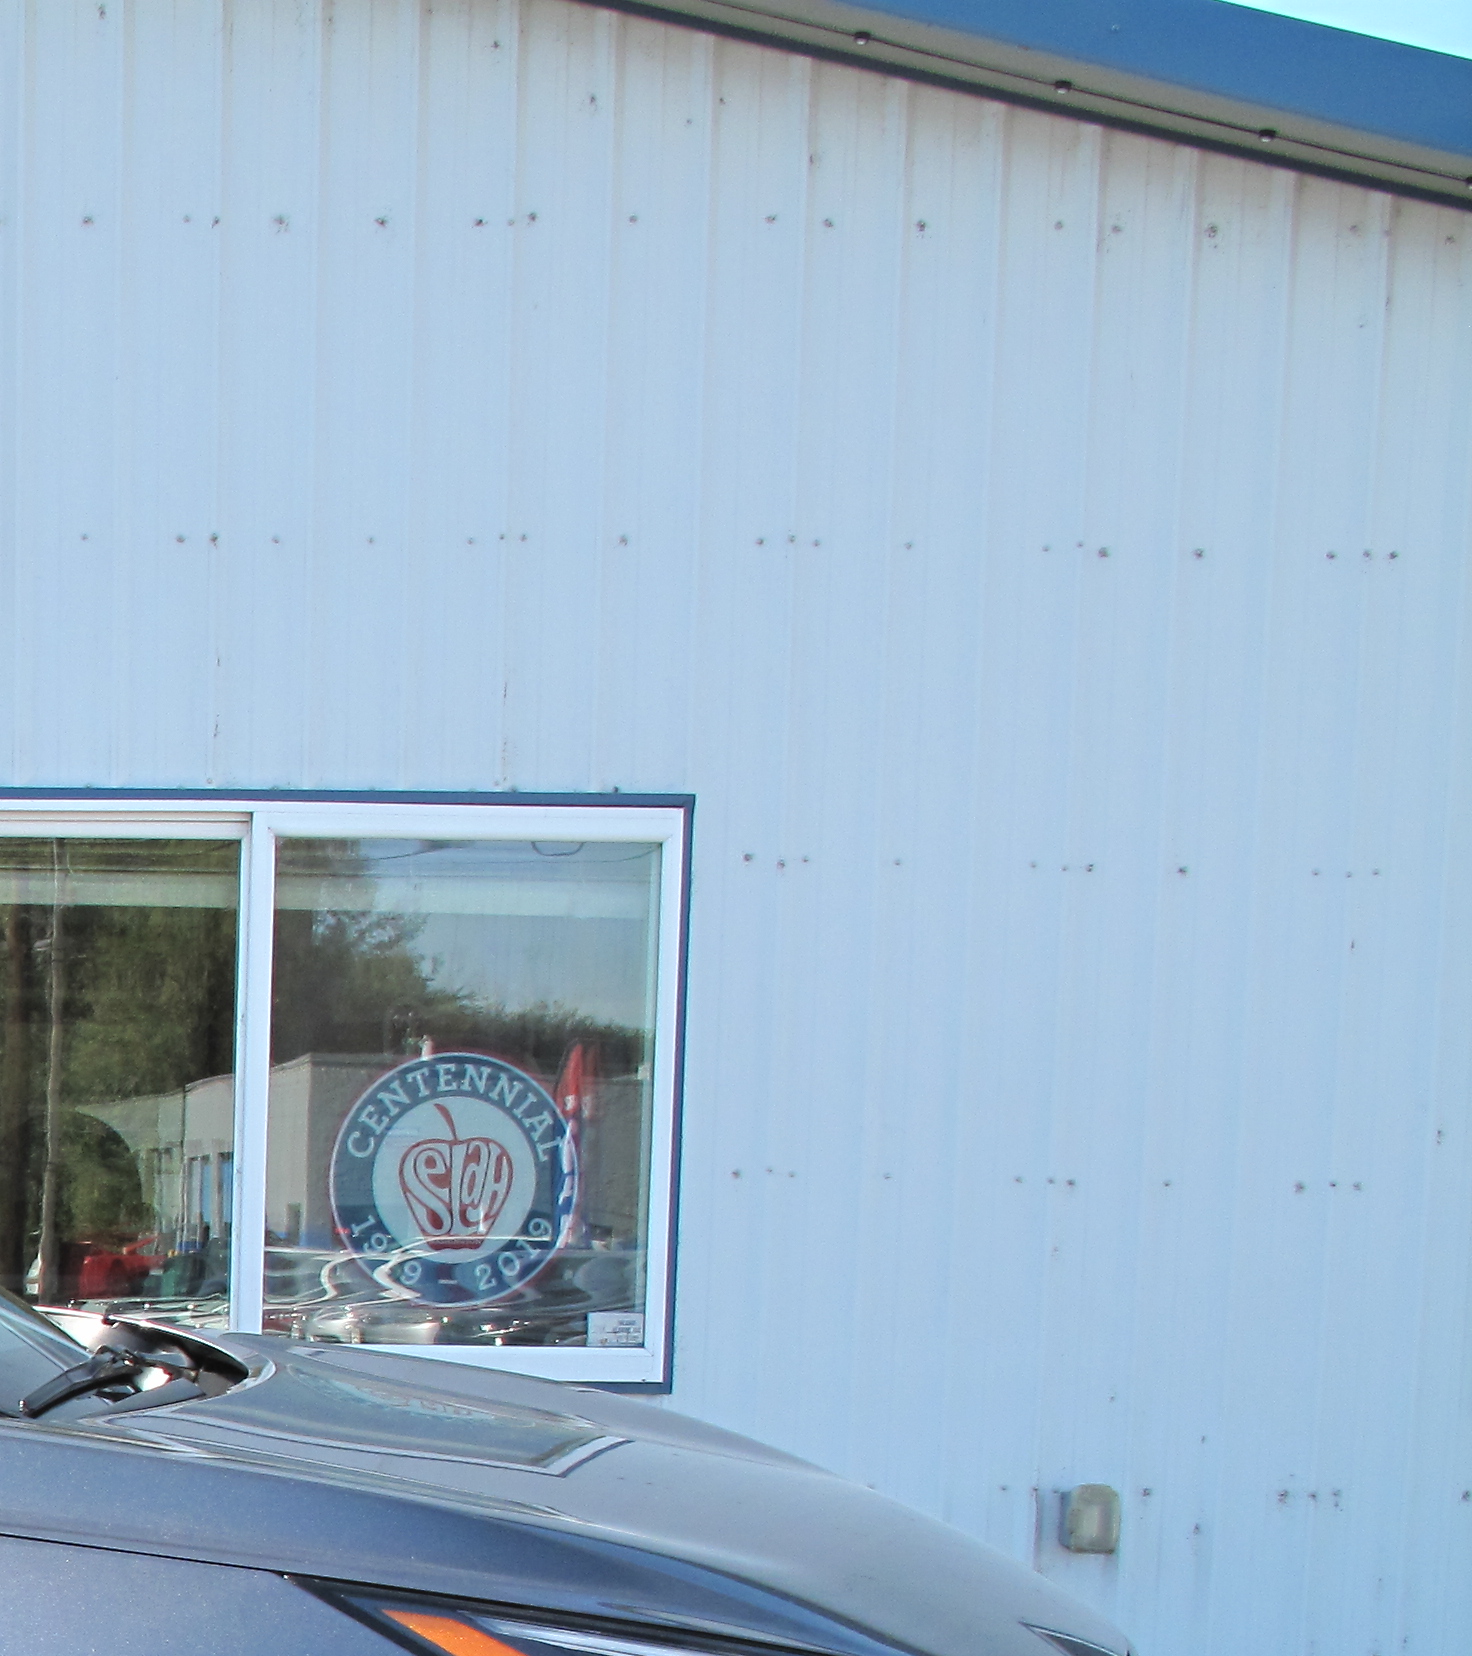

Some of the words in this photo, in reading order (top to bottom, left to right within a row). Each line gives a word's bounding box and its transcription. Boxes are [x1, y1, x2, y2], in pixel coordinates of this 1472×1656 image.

[347, 1062, 563, 1161] CENTENNIAL
[350, 1214, 423, 1285] 199
[475, 1218, 552, 1291] 2019
